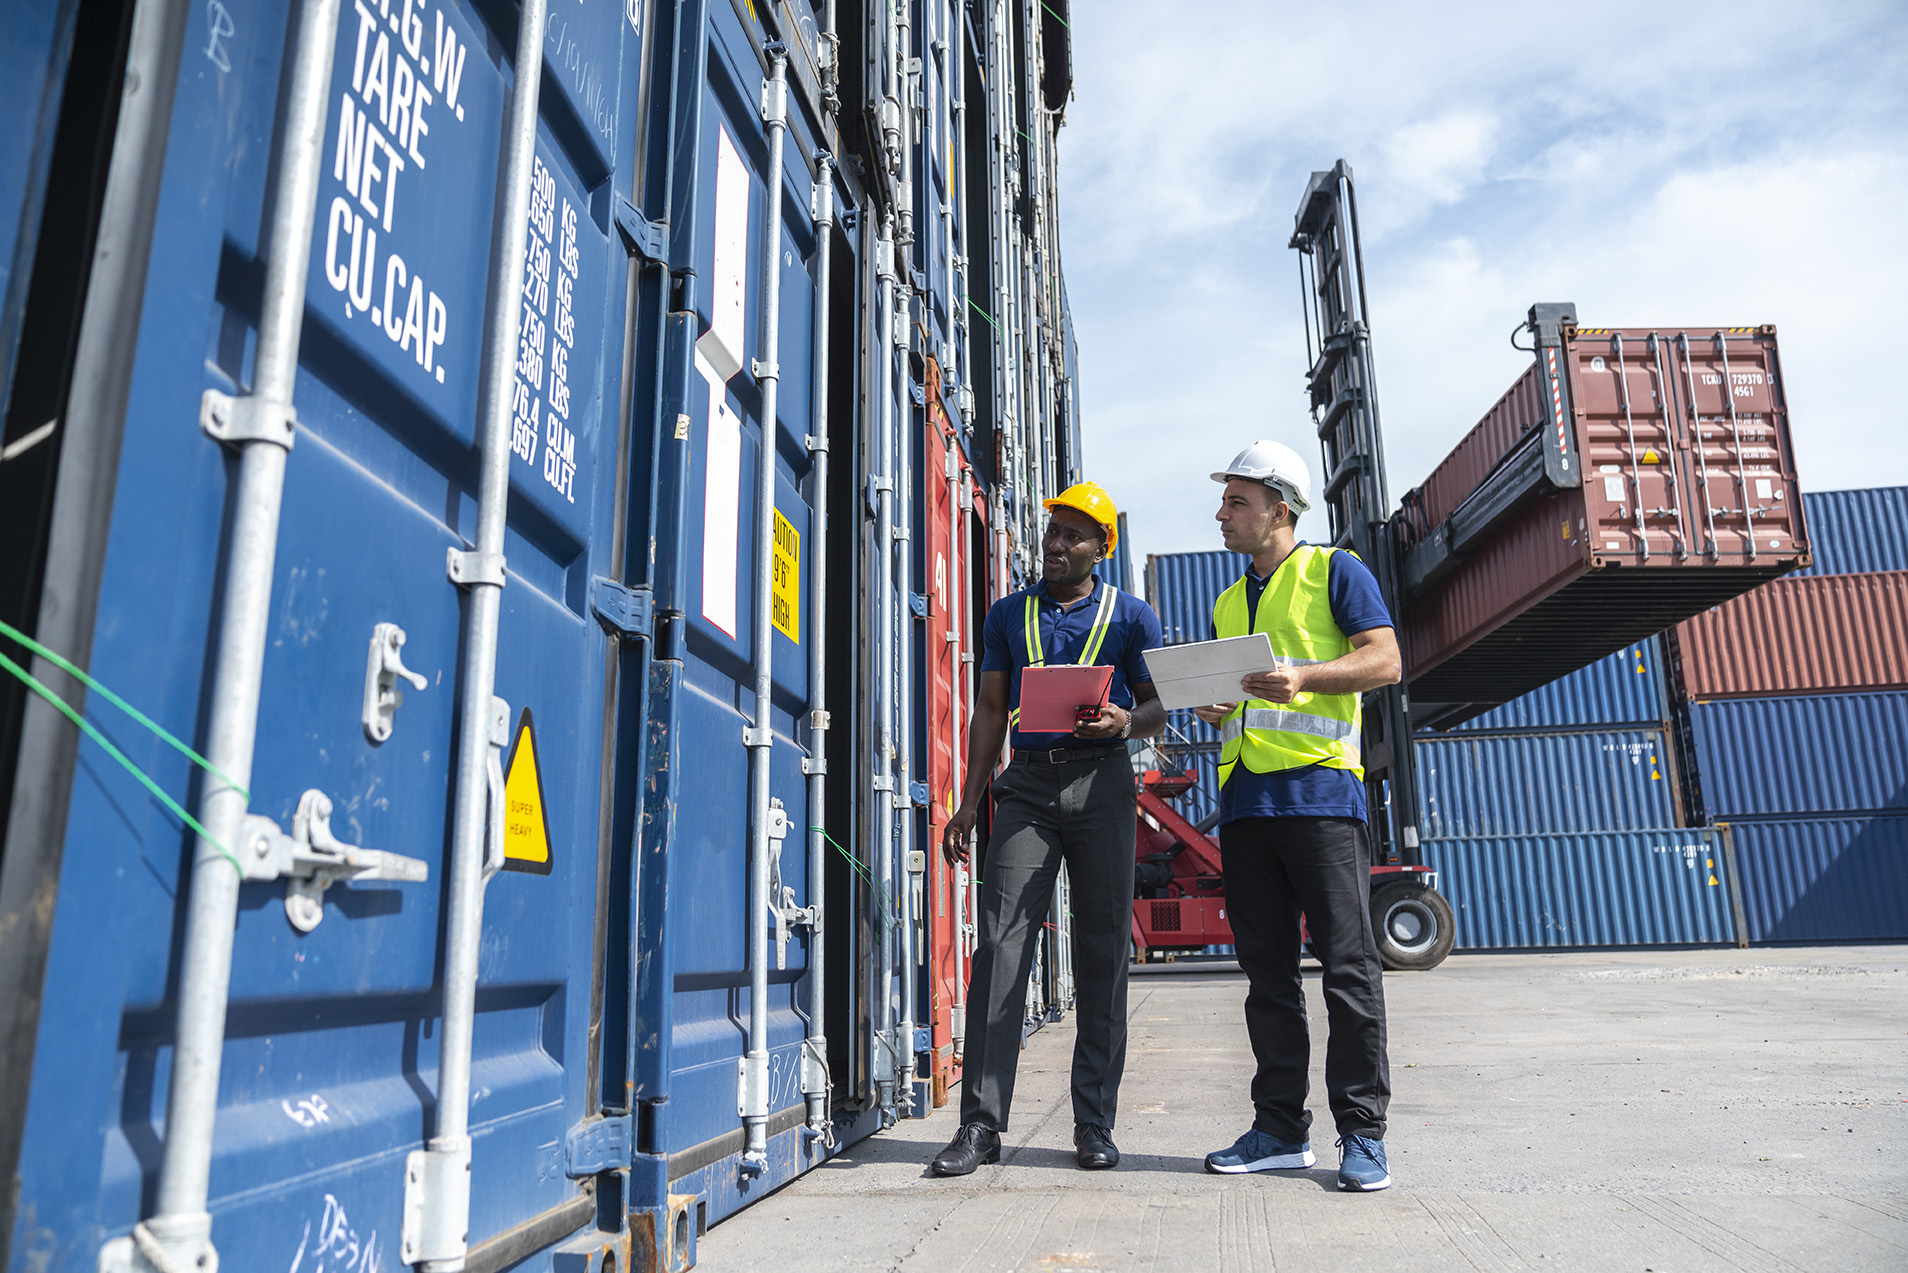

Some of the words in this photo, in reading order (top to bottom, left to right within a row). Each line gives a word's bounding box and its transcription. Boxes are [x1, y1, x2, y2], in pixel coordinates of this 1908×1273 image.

[352, 0, 433, 170] TARE
[370, 0, 467, 123] .G.W.
[334, 92, 405, 233] NET
[530, 155, 556, 212] .500
[561, 197, 577, 244] KG
[524, 227, 551, 283] .750
[556, 266, 573, 313] KG
[527, 189, 554, 244] .650
[559, 229, 579, 280] LBS
[325, 196, 447, 384] CU.CAP.
[521, 263, 549, 317] .270
[554, 299, 575, 349] LBS
[515, 338, 543, 391] .380
[549, 370, 570, 420] LBS
[518, 302, 546, 356] .750
[551, 337, 568, 383] KG
[1701, 374, 1722, 385] TCKU
[1732, 373, 1763, 385] 729370
[1734, 386, 1754, 397] 45G1
[509, 415, 538, 467] .697
[543, 446, 575, 504] CU.FT.
[546, 411, 577, 471] CU.M.
[1561, 458, 1569, 471] 8
[773, 512, 798, 562] AUTION
[773, 591, 790, 632] HIGH
[510, 823, 532, 837] HEAVY
[511, 800, 534, 816] SUPER
